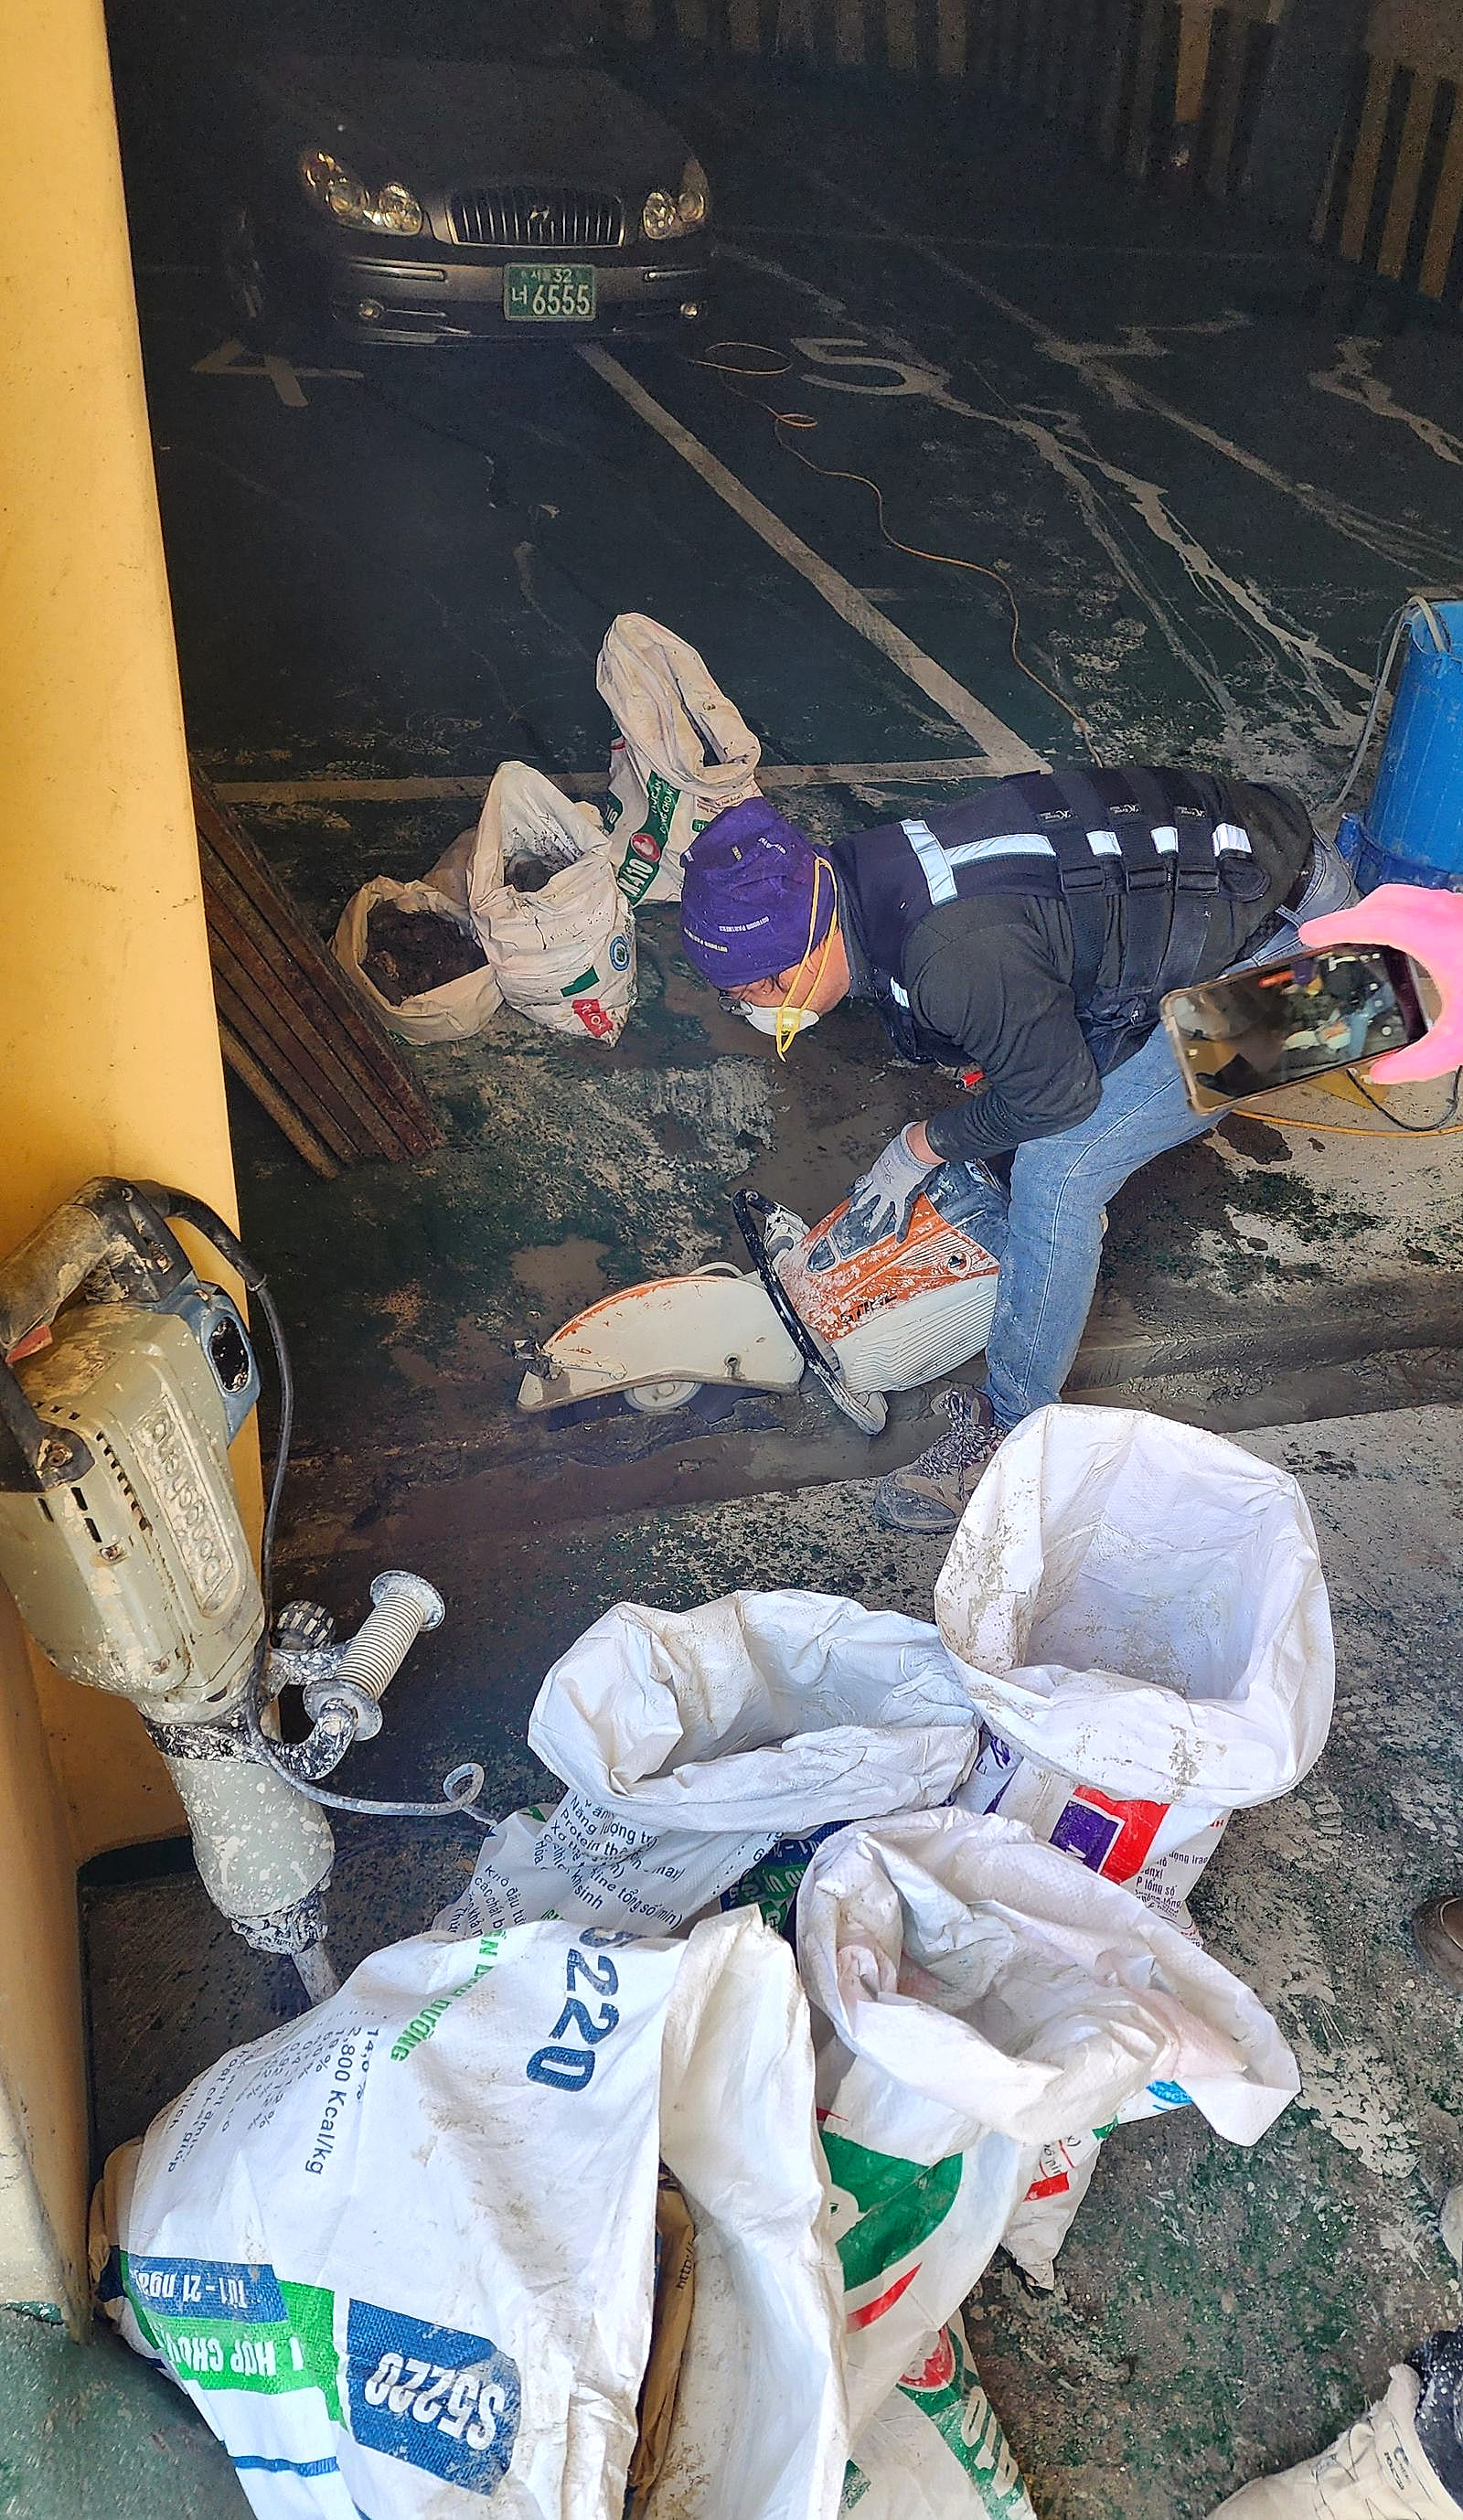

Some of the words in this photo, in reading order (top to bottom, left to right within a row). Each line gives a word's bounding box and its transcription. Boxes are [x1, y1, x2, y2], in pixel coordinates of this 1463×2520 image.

[512, 284, 528, 305] 너
[532, 284, 591, 315] 6555
[553, 268, 572, 283] 32
[791, 337, 933, 396] 5
[333, 2025, 362, 2084] 2,800
[304, 2088, 348, 2175] Kcal/kg
[182, 2273, 202, 2302] 21
[364, 2352, 506, 2451] S5220
